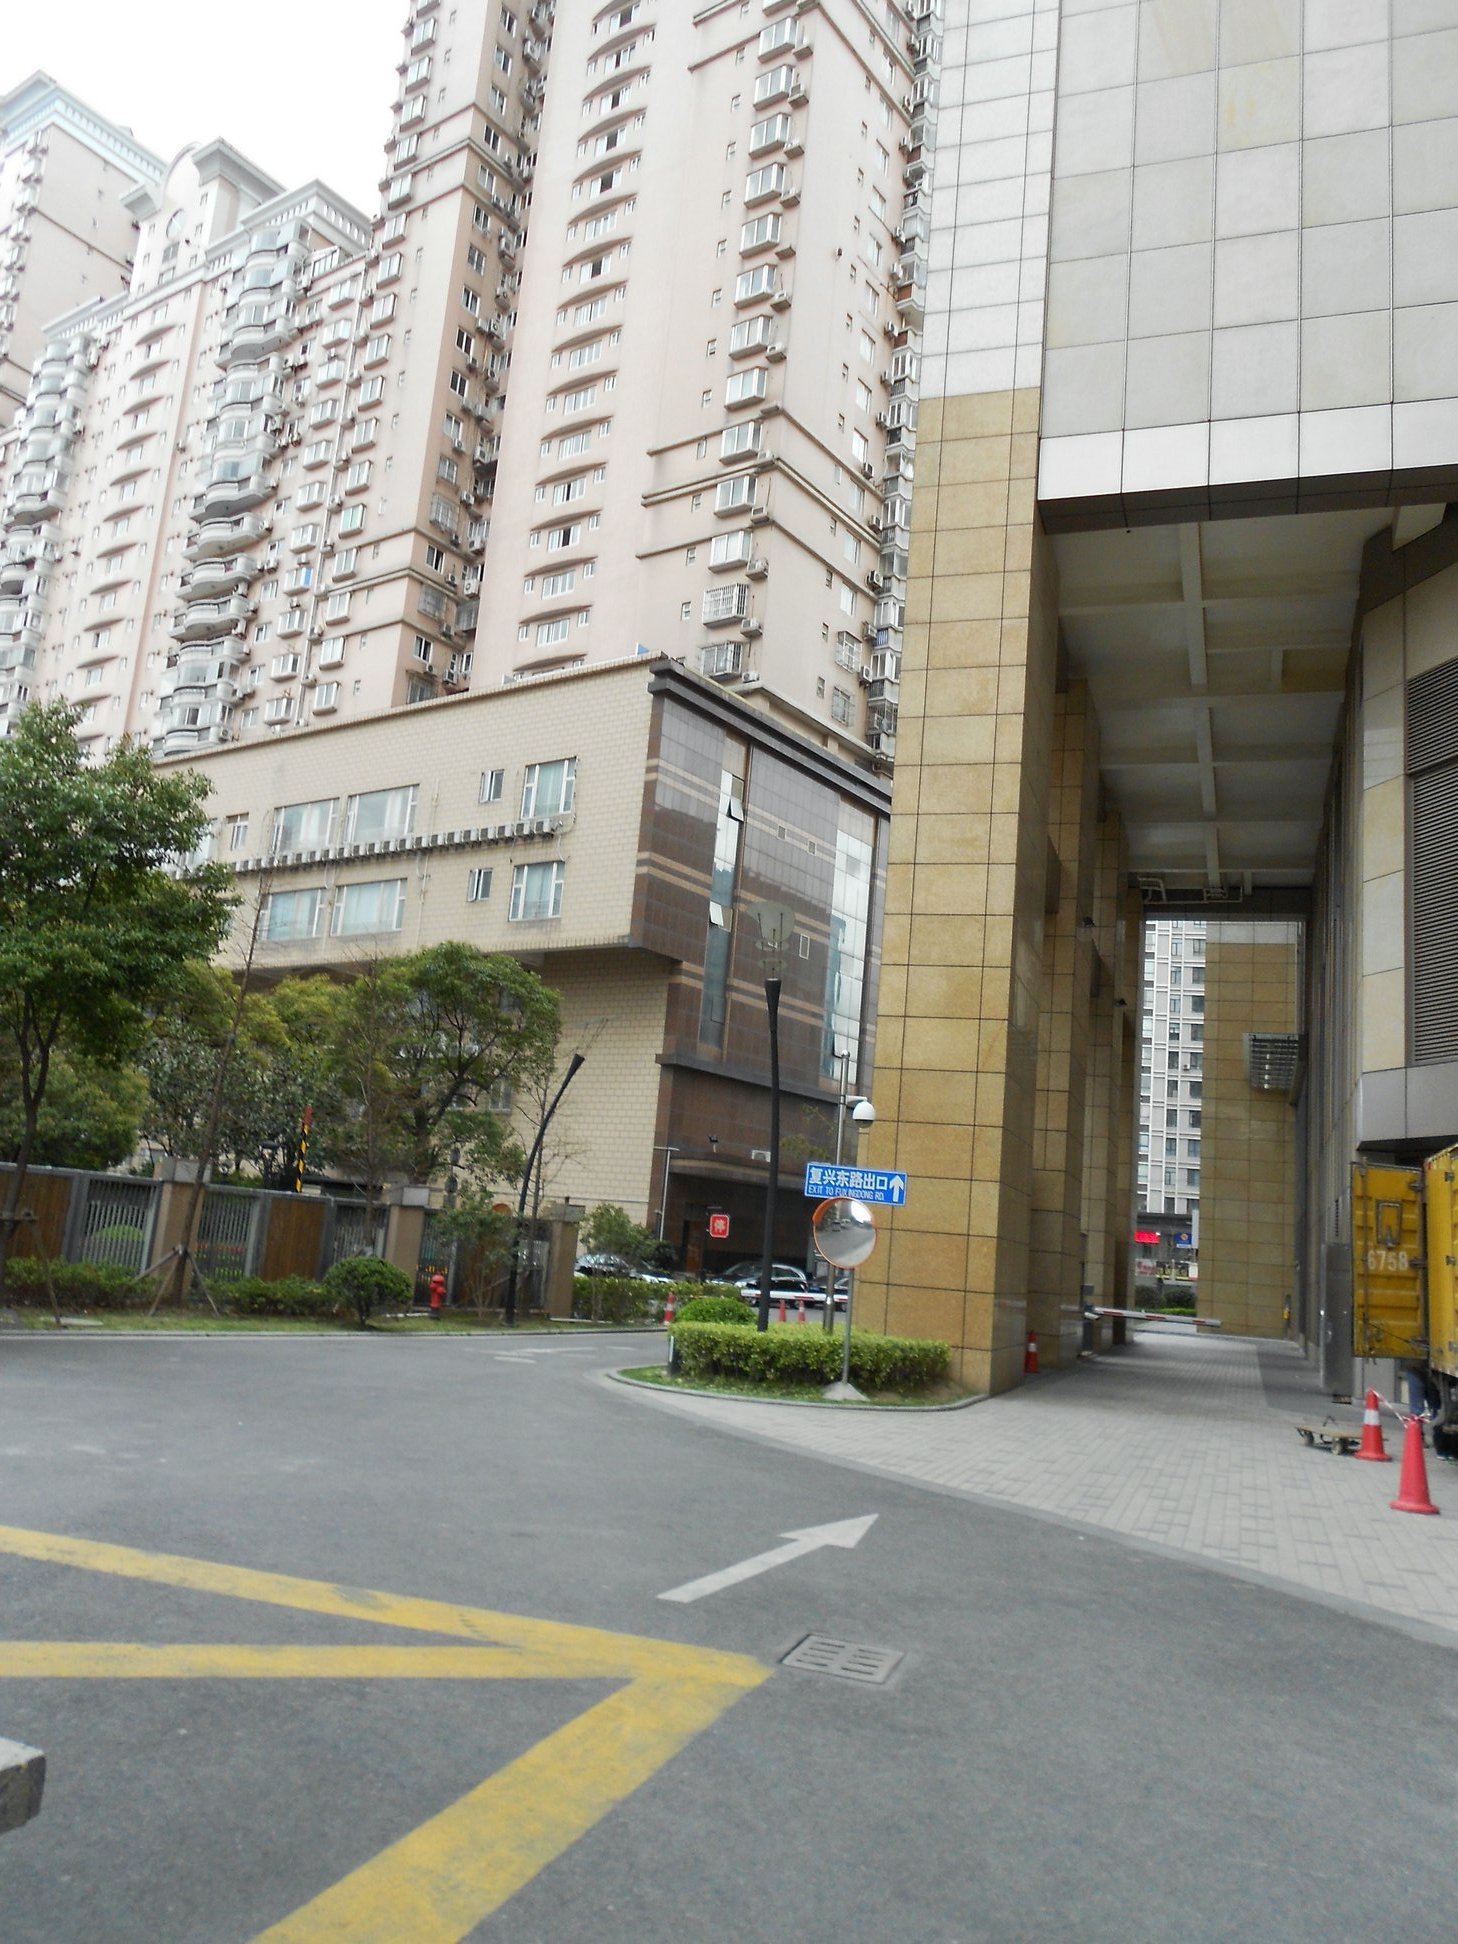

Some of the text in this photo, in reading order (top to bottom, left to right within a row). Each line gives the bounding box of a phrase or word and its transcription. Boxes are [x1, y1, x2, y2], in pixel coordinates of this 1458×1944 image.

[809, 1167, 888, 1190] 复兴东路出口
[808, 1185, 824, 1194] EXIT
[826, 1186, 834, 1195] TO
[1367, 1249, 1409, 1271] 6758
